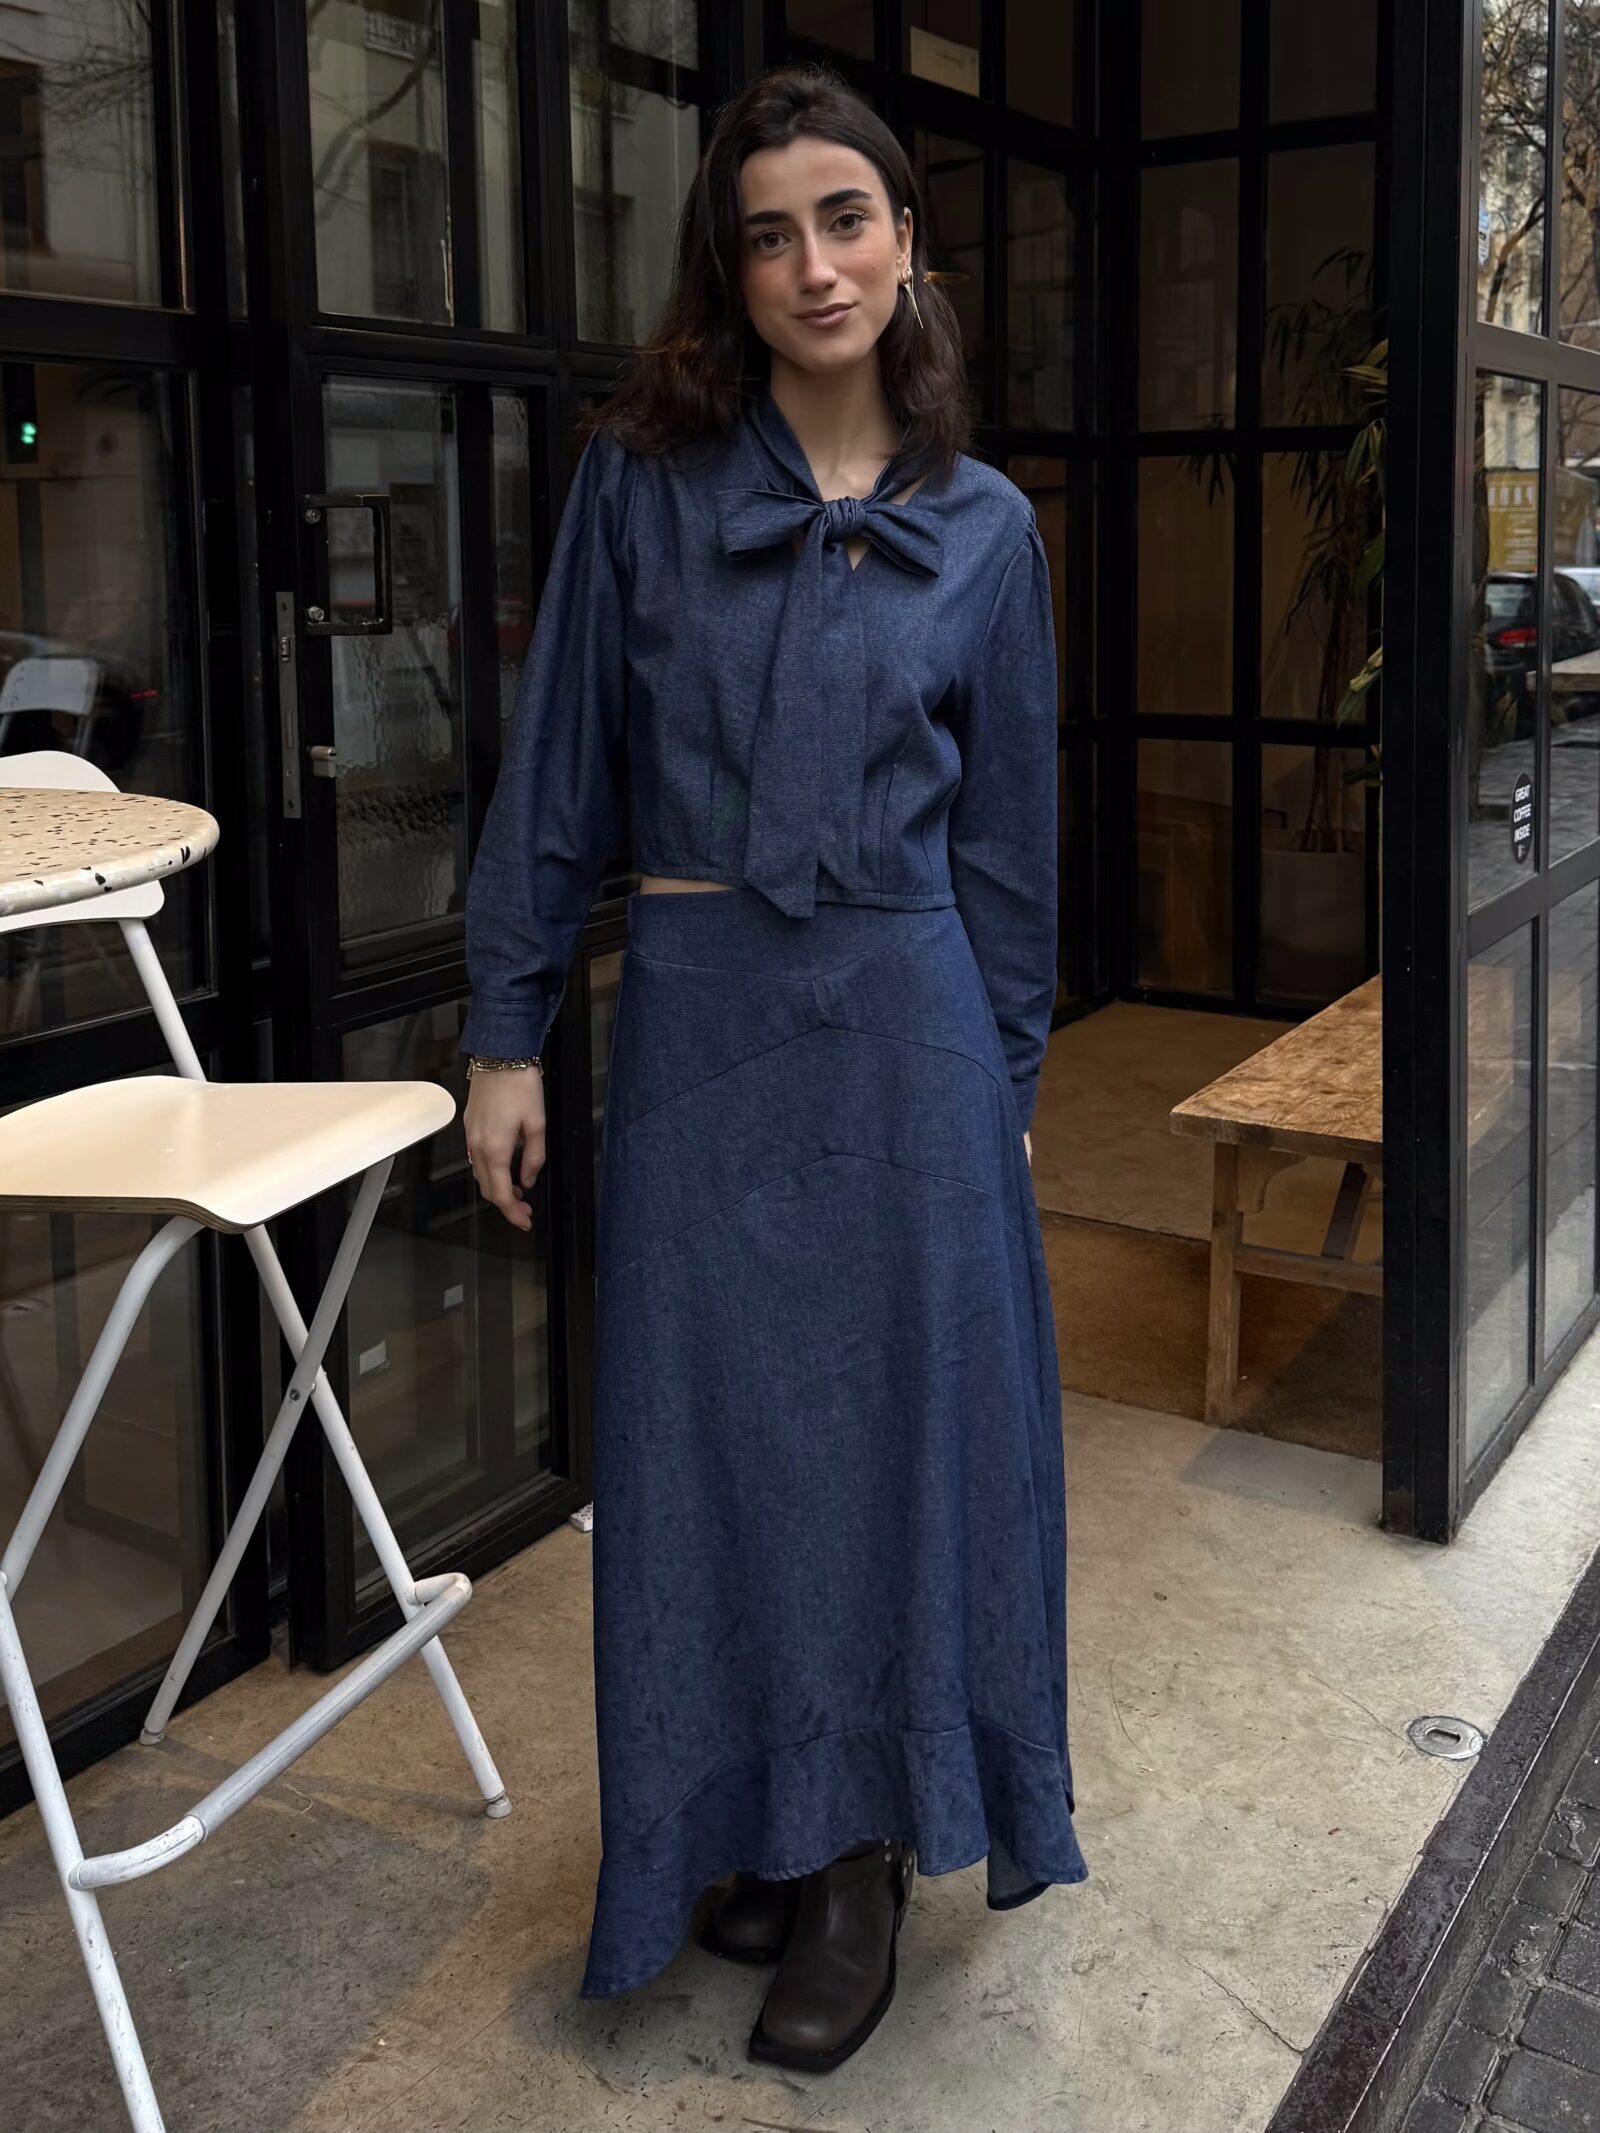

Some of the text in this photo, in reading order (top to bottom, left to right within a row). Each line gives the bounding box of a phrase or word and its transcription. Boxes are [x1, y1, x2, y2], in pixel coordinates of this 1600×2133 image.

[1515, 784, 1531, 802] GREAT
[1513, 803, 1532, 823] COFFEE
[1514, 823, 1530, 842] INSIDE
